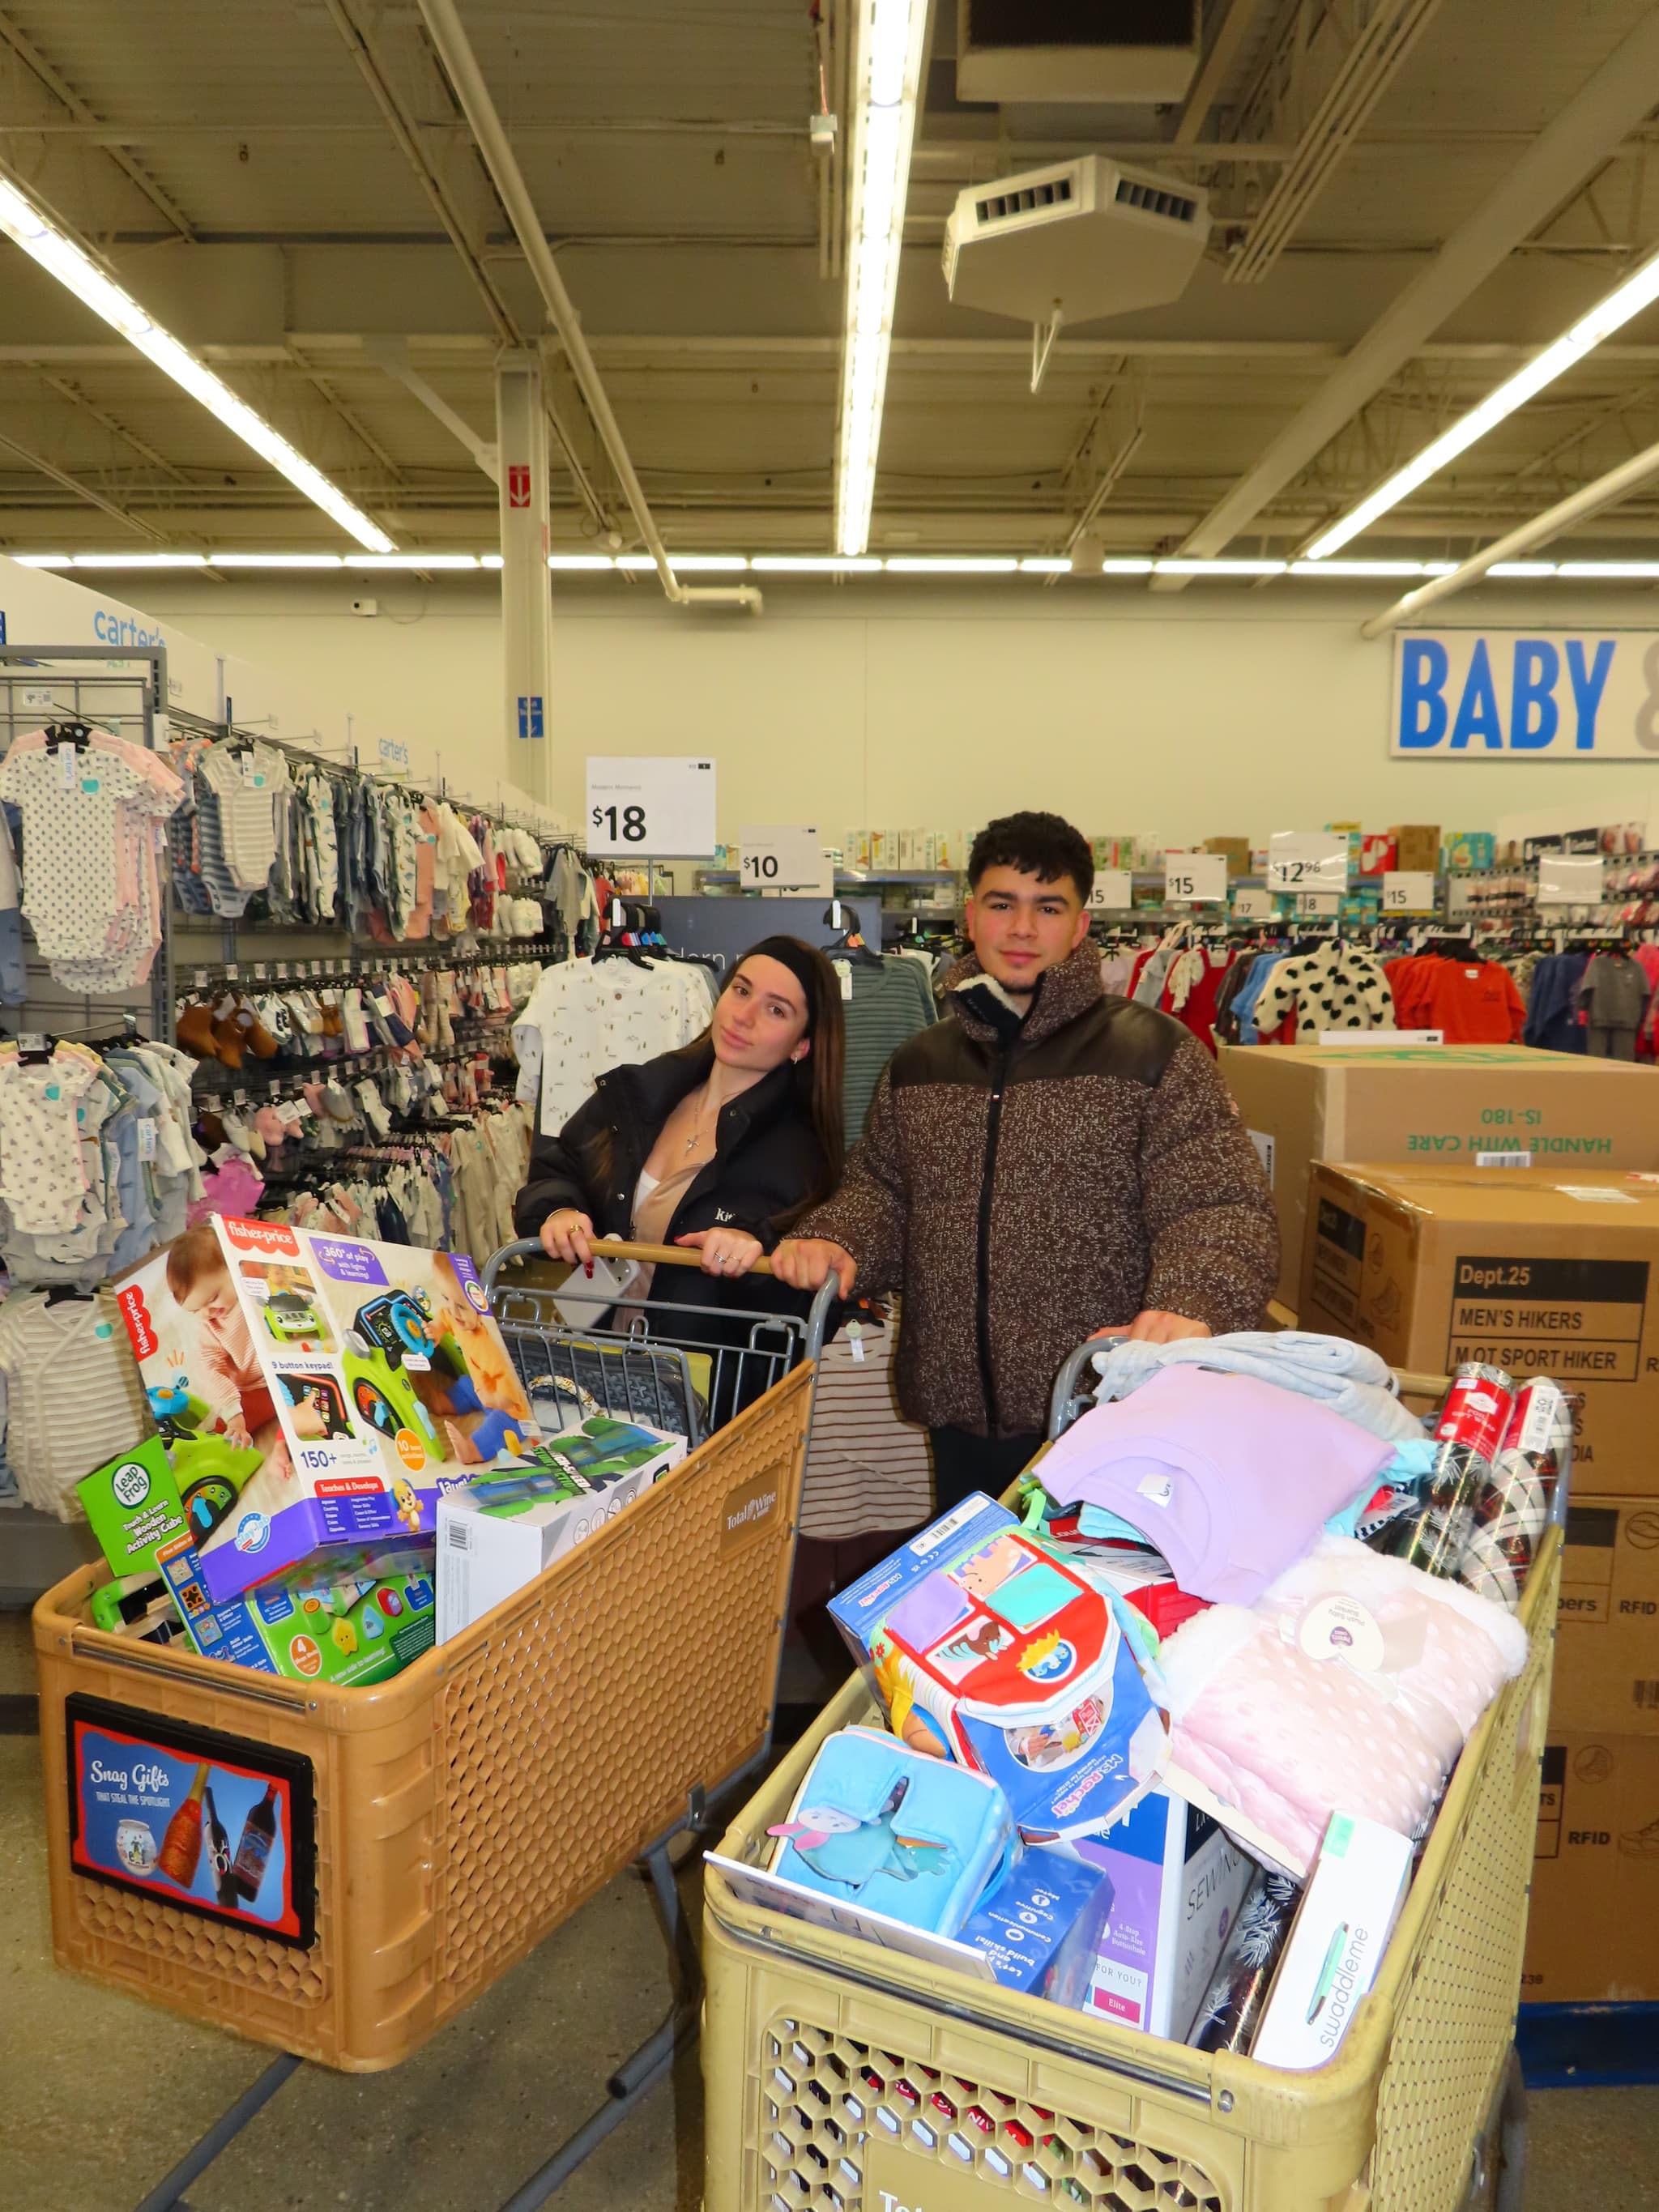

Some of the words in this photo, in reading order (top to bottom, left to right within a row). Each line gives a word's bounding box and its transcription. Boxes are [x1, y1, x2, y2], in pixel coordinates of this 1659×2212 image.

[1400, 639, 1617, 750] BABY
[592, 805, 646, 842] $18
[744, 855, 778, 878] $10
[1090, 889, 1105, 903] 15
[1168, 877, 1194, 894] $15
[1481, 1109, 1542, 1124] IS-180
[1407, 1135, 1461, 1151] CARE
[1469, 1135, 1520, 1152] WITH
[1529, 1136, 1612, 1153] HANDLE
[228, 1221, 293, 1245] fisher-price
[1460, 1264, 1531, 1289] Dept.25
[126, 1291, 151, 1355] fisher-price
[1460, 1308, 1513, 1328] MEN'S
[1518, 1311, 1583, 1329] HIKERS
[279, 1362, 304, 1370] button
[1500, 1348, 1560, 1367] SPORT
[1563, 1350, 1617, 1370] HIKER
[397, 1440, 409, 1451] 10
[301, 1450, 337, 1469] 150+
[116, 1466, 139, 1493] Leap
[123, 1475, 148, 1502] Frog
[727, 1505, 747, 1530] Total
[755, 1491, 777, 1511] Wine
[126, 1528, 162, 1555] Activity
[160, 1515, 184, 1534] Cube
[133, 1513, 167, 1537] Wooden
[1620, 1600, 1657, 1615] RFID
[90, 1760, 128, 1791] Snag
[132, 1763, 169, 1792] Gifts
[110, 1792, 128, 1805] STEAL
[139, 1794, 171, 1808] SPOTLIGHT
[1051, 1771, 1103, 1818] Rachel
[1568, 1831, 1611, 1845] RFID
[1015, 1900, 1054, 1921] Cognitive
[987, 1912, 1051, 1943] Communication
[1007, 1950, 1035, 1967] build
[1096, 1963, 1114, 1976] FOR
[1117, 1971, 1142, 1988] YOU?
[1320, 1926, 1369, 2048] swaddleme
[1108, 1997, 1126, 2012] Elite
